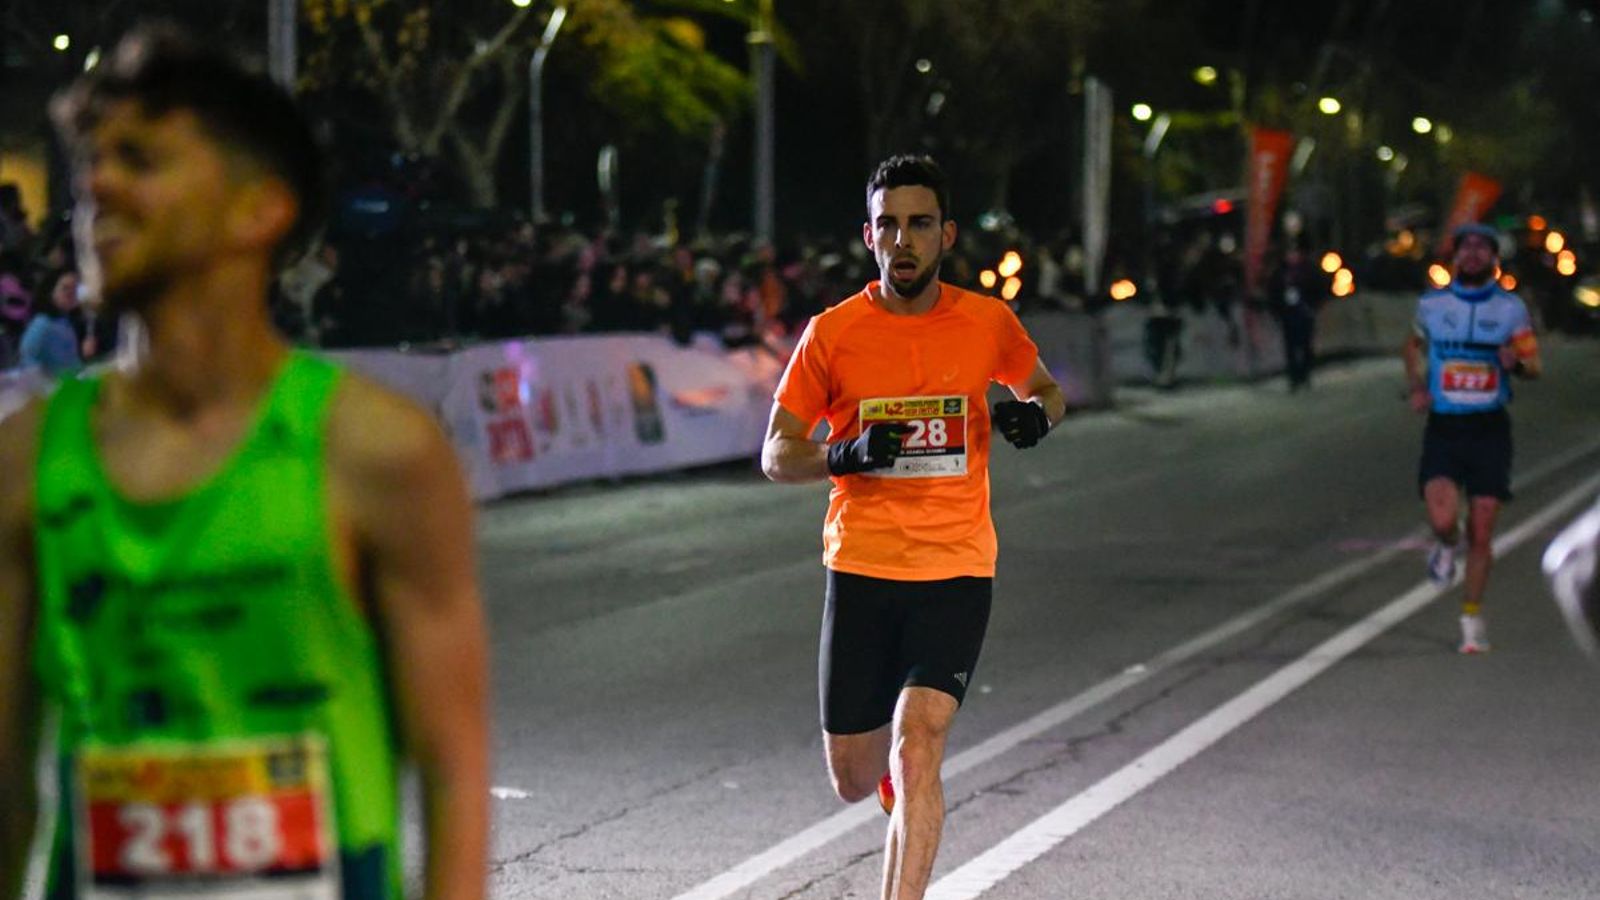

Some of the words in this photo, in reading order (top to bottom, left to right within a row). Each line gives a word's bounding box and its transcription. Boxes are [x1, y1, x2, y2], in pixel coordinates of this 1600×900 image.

[1453, 372, 1489, 388] 727
[902, 419, 948, 447] 28
[119, 798, 281, 871] 218
